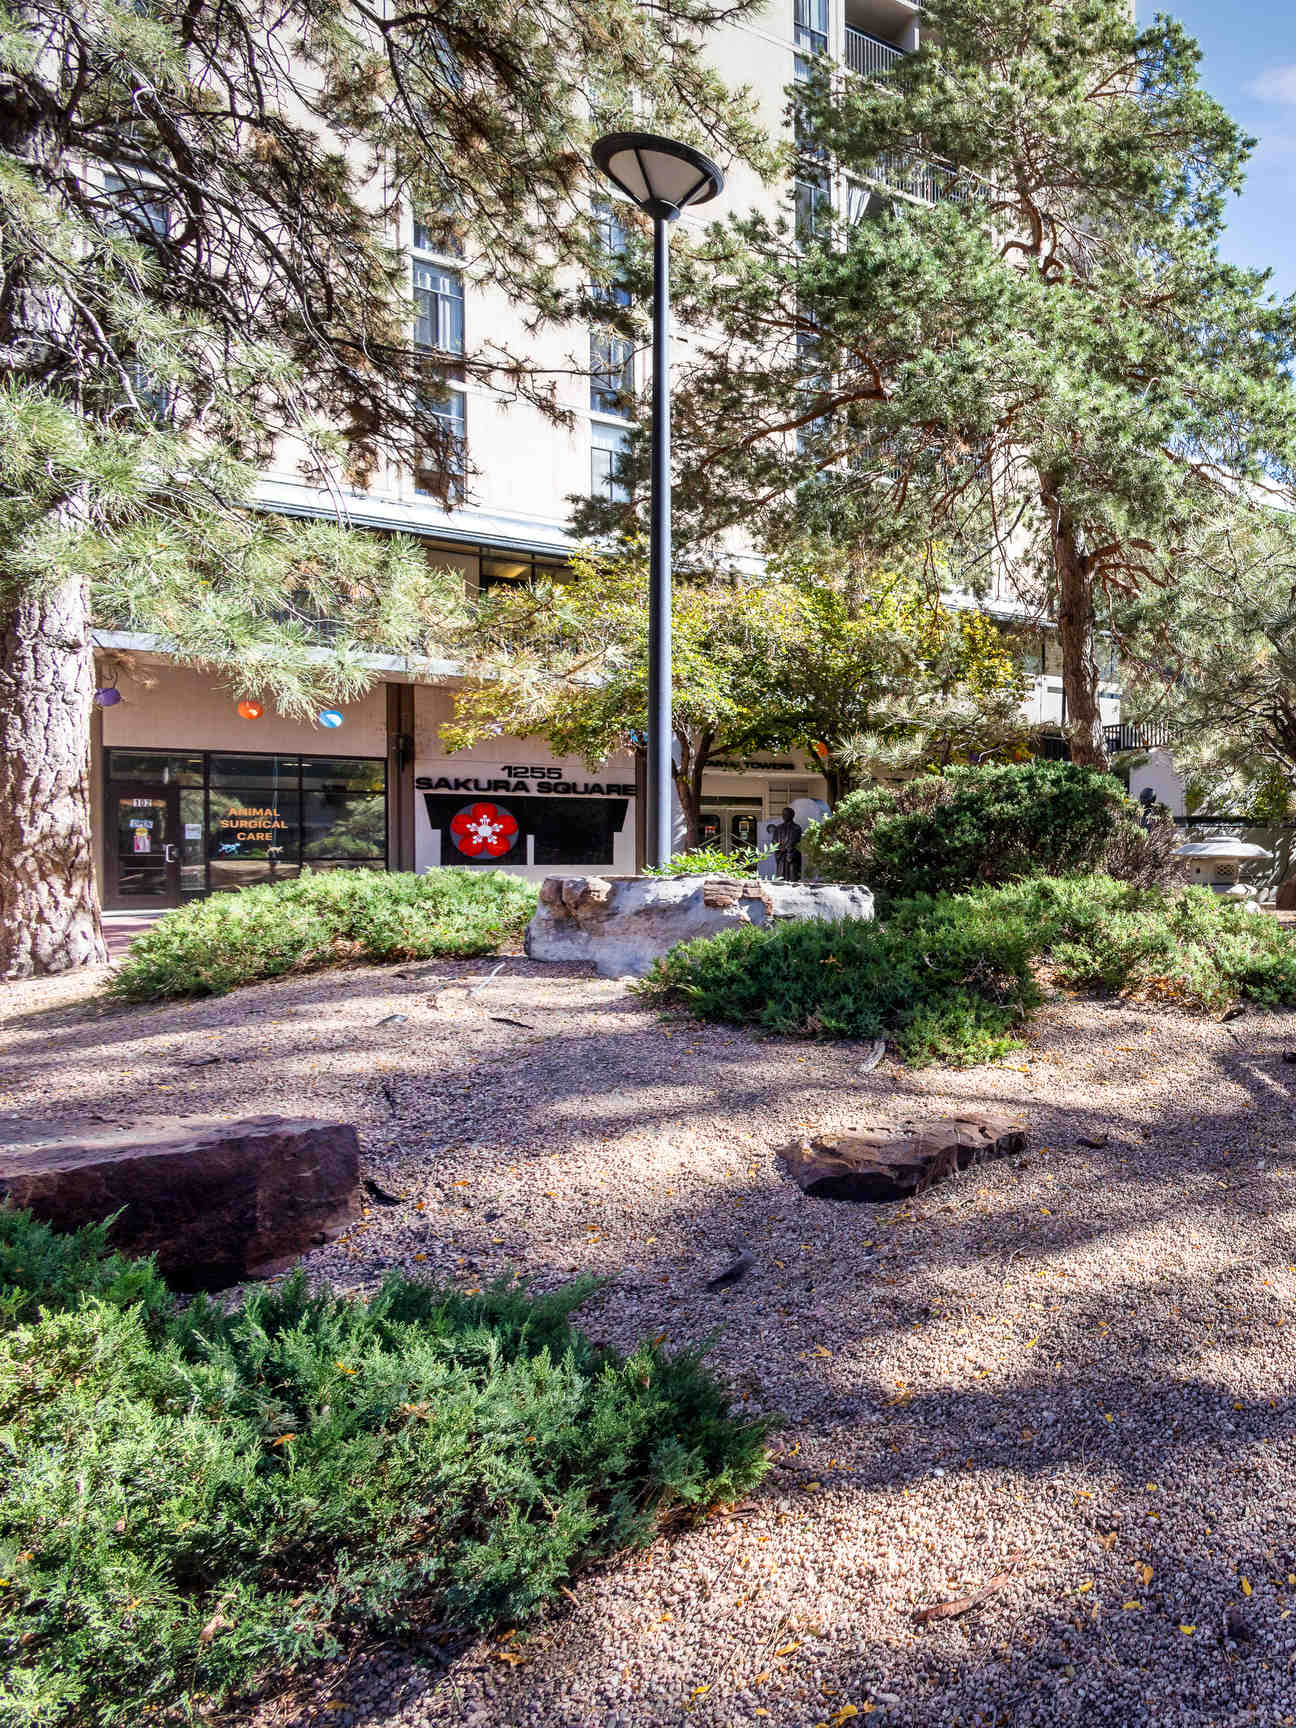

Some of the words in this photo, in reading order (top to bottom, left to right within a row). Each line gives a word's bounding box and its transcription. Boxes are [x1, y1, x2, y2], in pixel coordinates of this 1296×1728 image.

[501, 765, 563, 780] 1255
[415, 776, 530, 793] SAKURA
[536, 780, 638, 797] SQUARE
[228, 807, 281, 817] ANIMAL
[220, 819, 289, 829] SURGICAL
[236, 831, 273, 841] CARE
